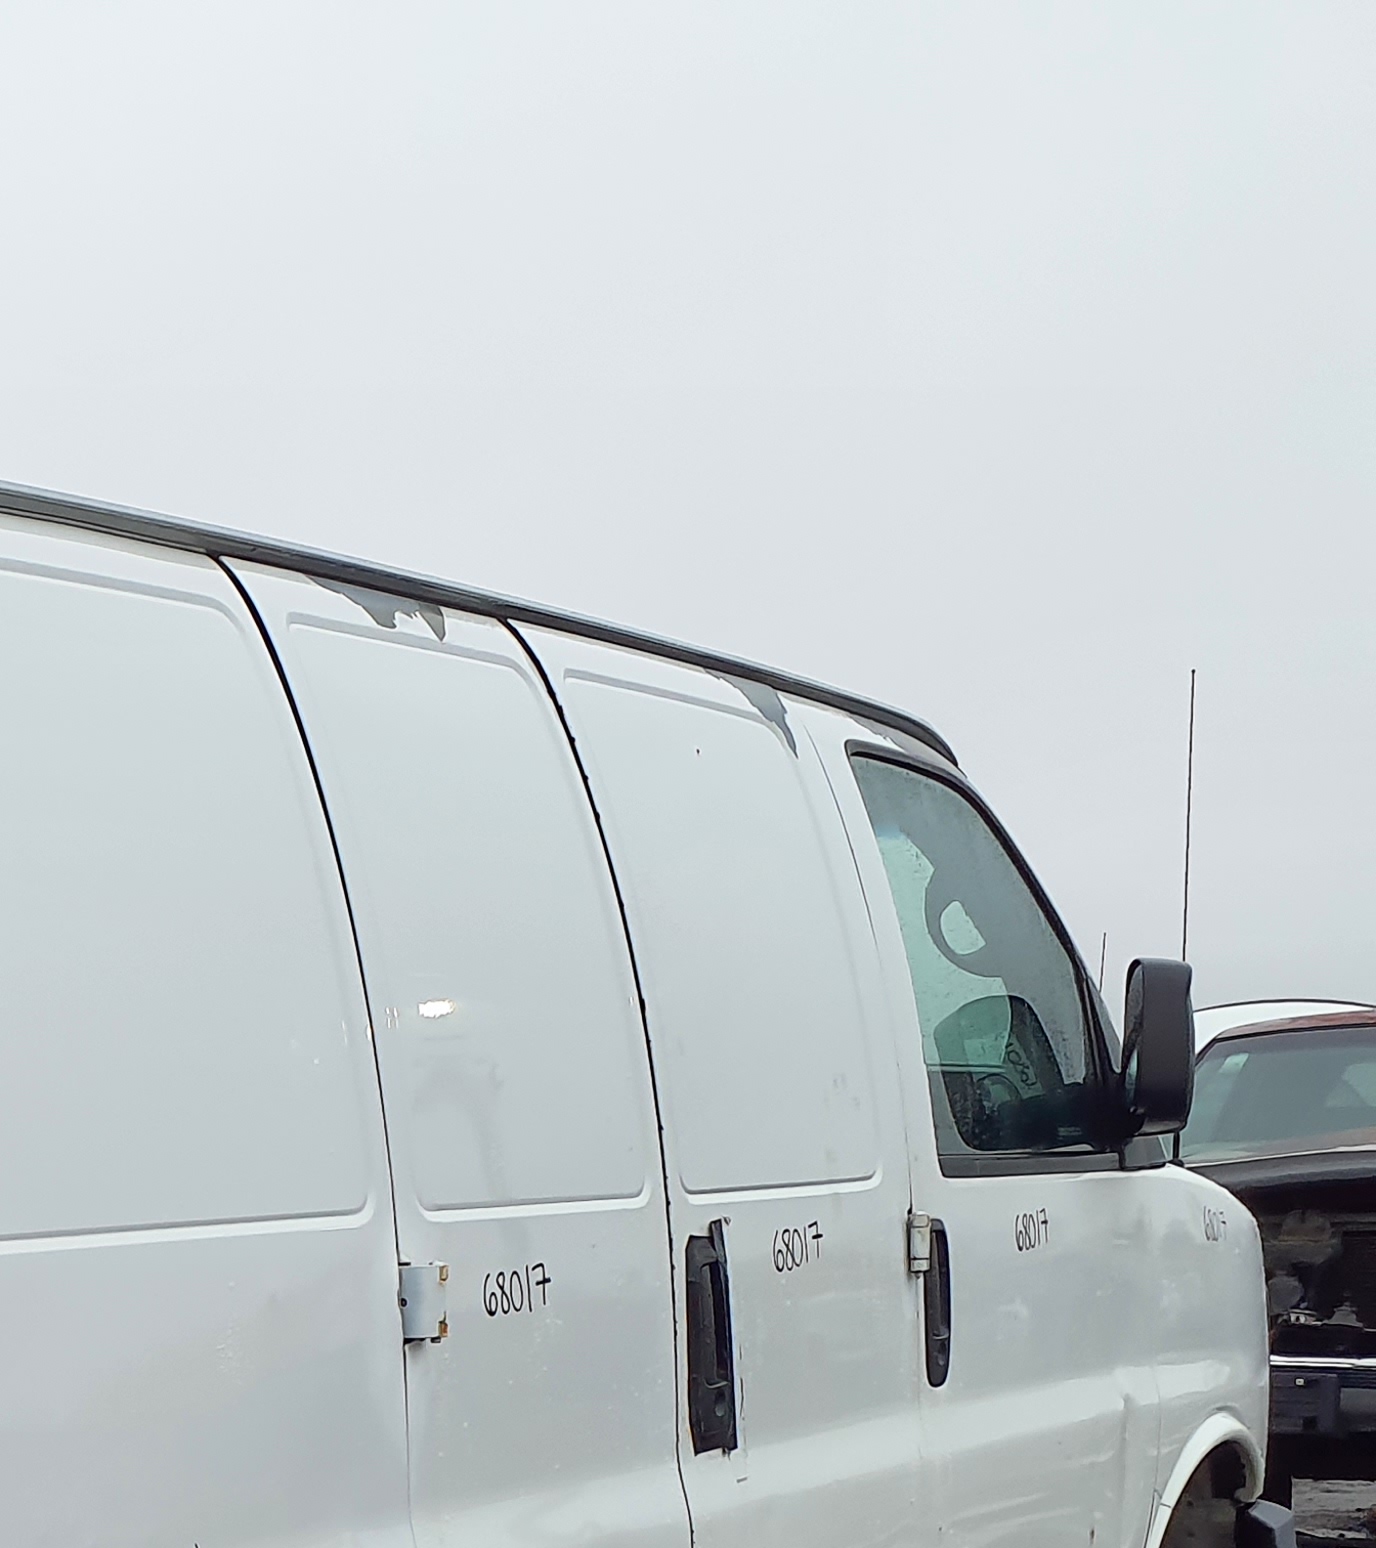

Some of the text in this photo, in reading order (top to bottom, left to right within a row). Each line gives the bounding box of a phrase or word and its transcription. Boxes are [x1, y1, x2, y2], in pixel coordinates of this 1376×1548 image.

[773, 1220, 823, 1272] 68017
[1015, 1208, 1049, 1252] 68017
[483, 1262, 551, 1317] 68017
